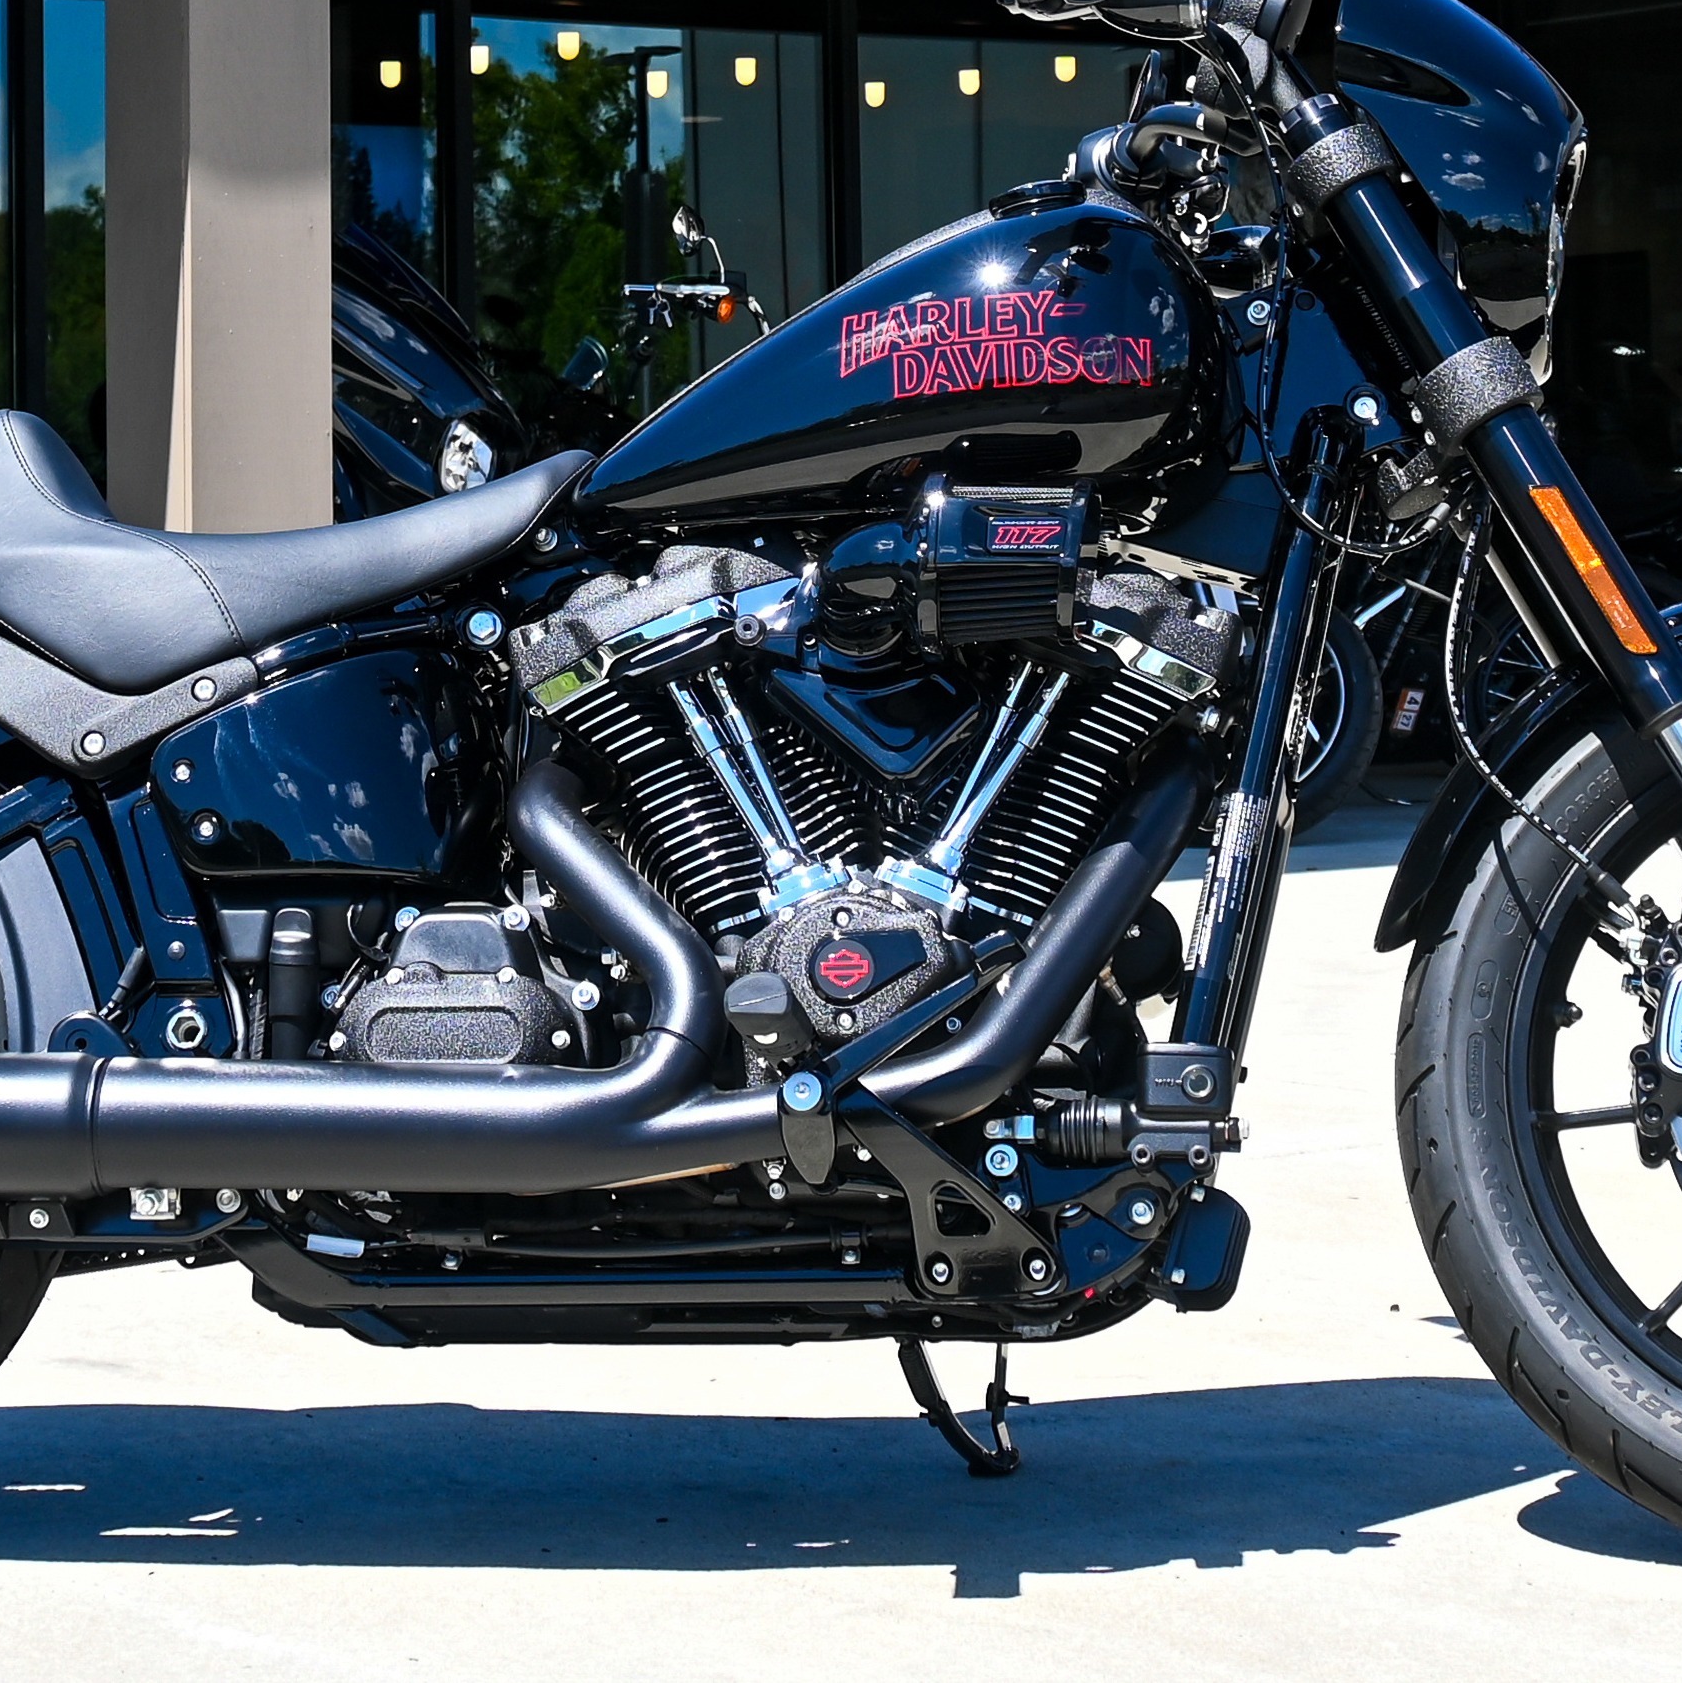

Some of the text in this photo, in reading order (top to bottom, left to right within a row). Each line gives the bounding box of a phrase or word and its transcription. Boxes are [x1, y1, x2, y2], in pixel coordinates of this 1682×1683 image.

[839, 290, 1087, 379] HARLEY-
[892, 337, 1153, 399] DAVIDSON
[994, 525, 1062, 545] 117
[1407, 697, 1420, 706] 4
[1400, 714, 1413, 728] 27
